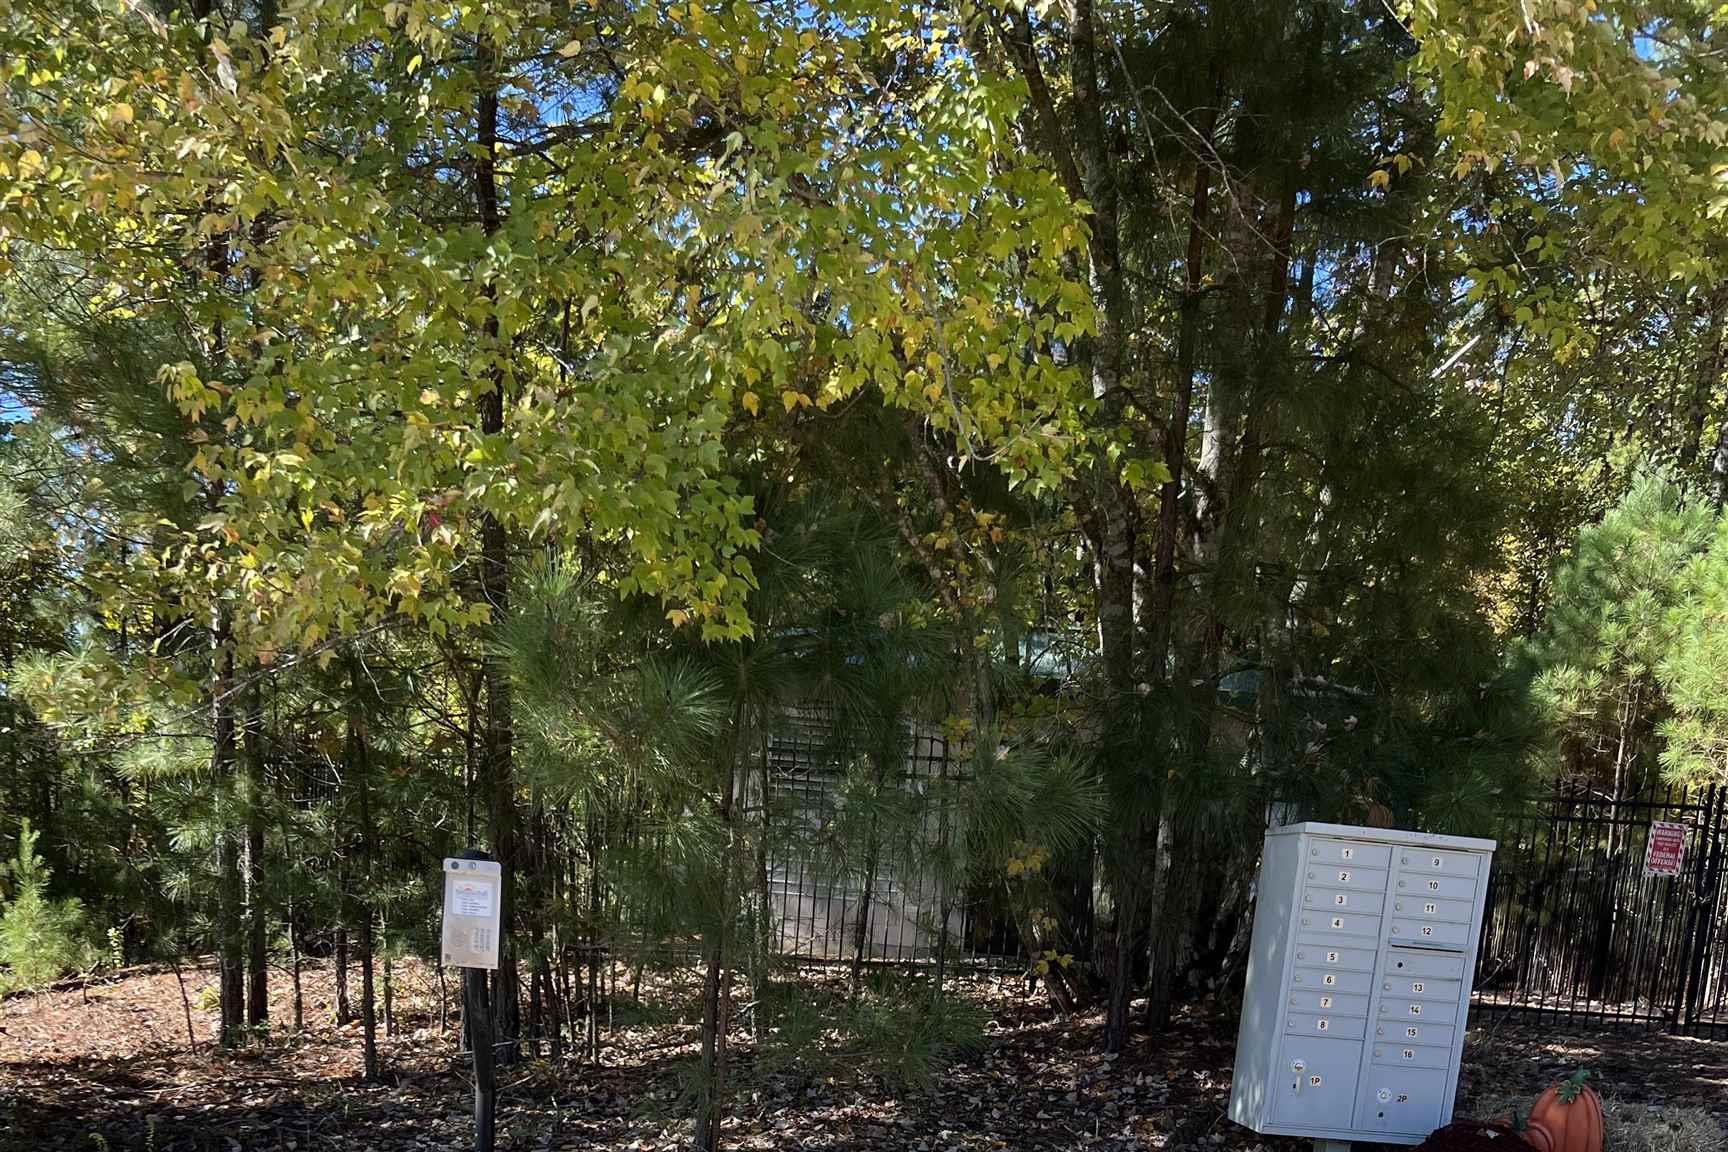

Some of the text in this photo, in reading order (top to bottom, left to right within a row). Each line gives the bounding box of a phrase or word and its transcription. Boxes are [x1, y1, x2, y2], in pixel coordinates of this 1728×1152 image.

[1429, 881, 1439, 890] 10
[1426, 904, 1435, 913] 11
[1422, 927, 1432, 936] 12
[1414, 983, 1423, 992] 13
[1410, 1006, 1420, 1014] 14
[1407, 1028, 1416, 1036] 15
[1404, 1050, 1413, 1059] 16
[1310, 1077, 1321, 1085] 1P
